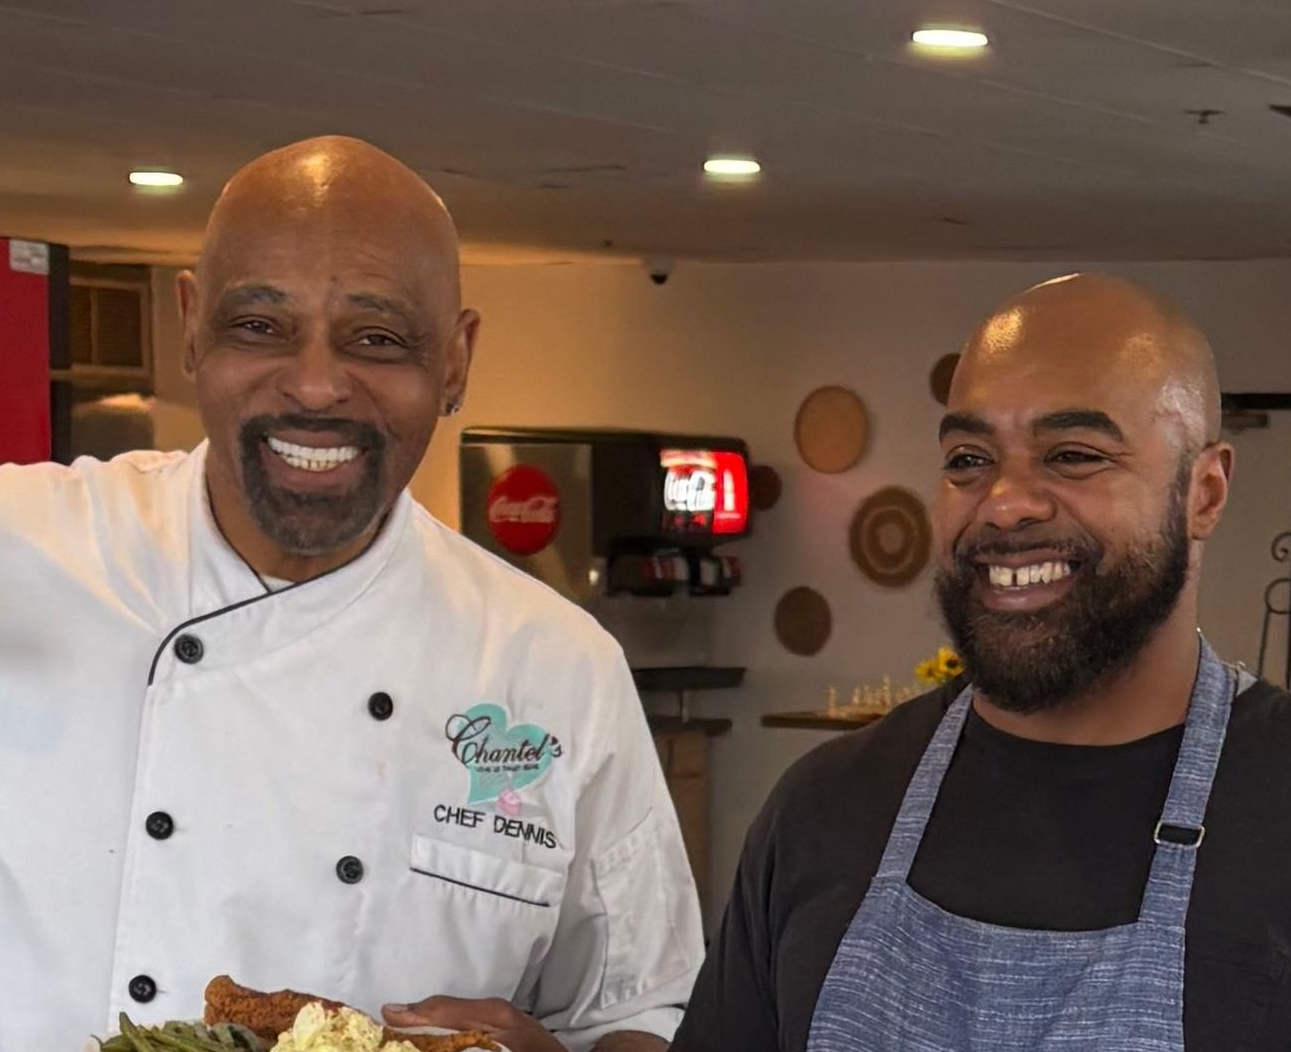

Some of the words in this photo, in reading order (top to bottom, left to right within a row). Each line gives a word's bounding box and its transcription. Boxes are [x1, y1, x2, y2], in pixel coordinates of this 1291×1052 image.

[445, 713, 562, 765] Chantel's
[433, 804, 486, 828] CHEF
[493, 815, 557, 849] DENNIS
